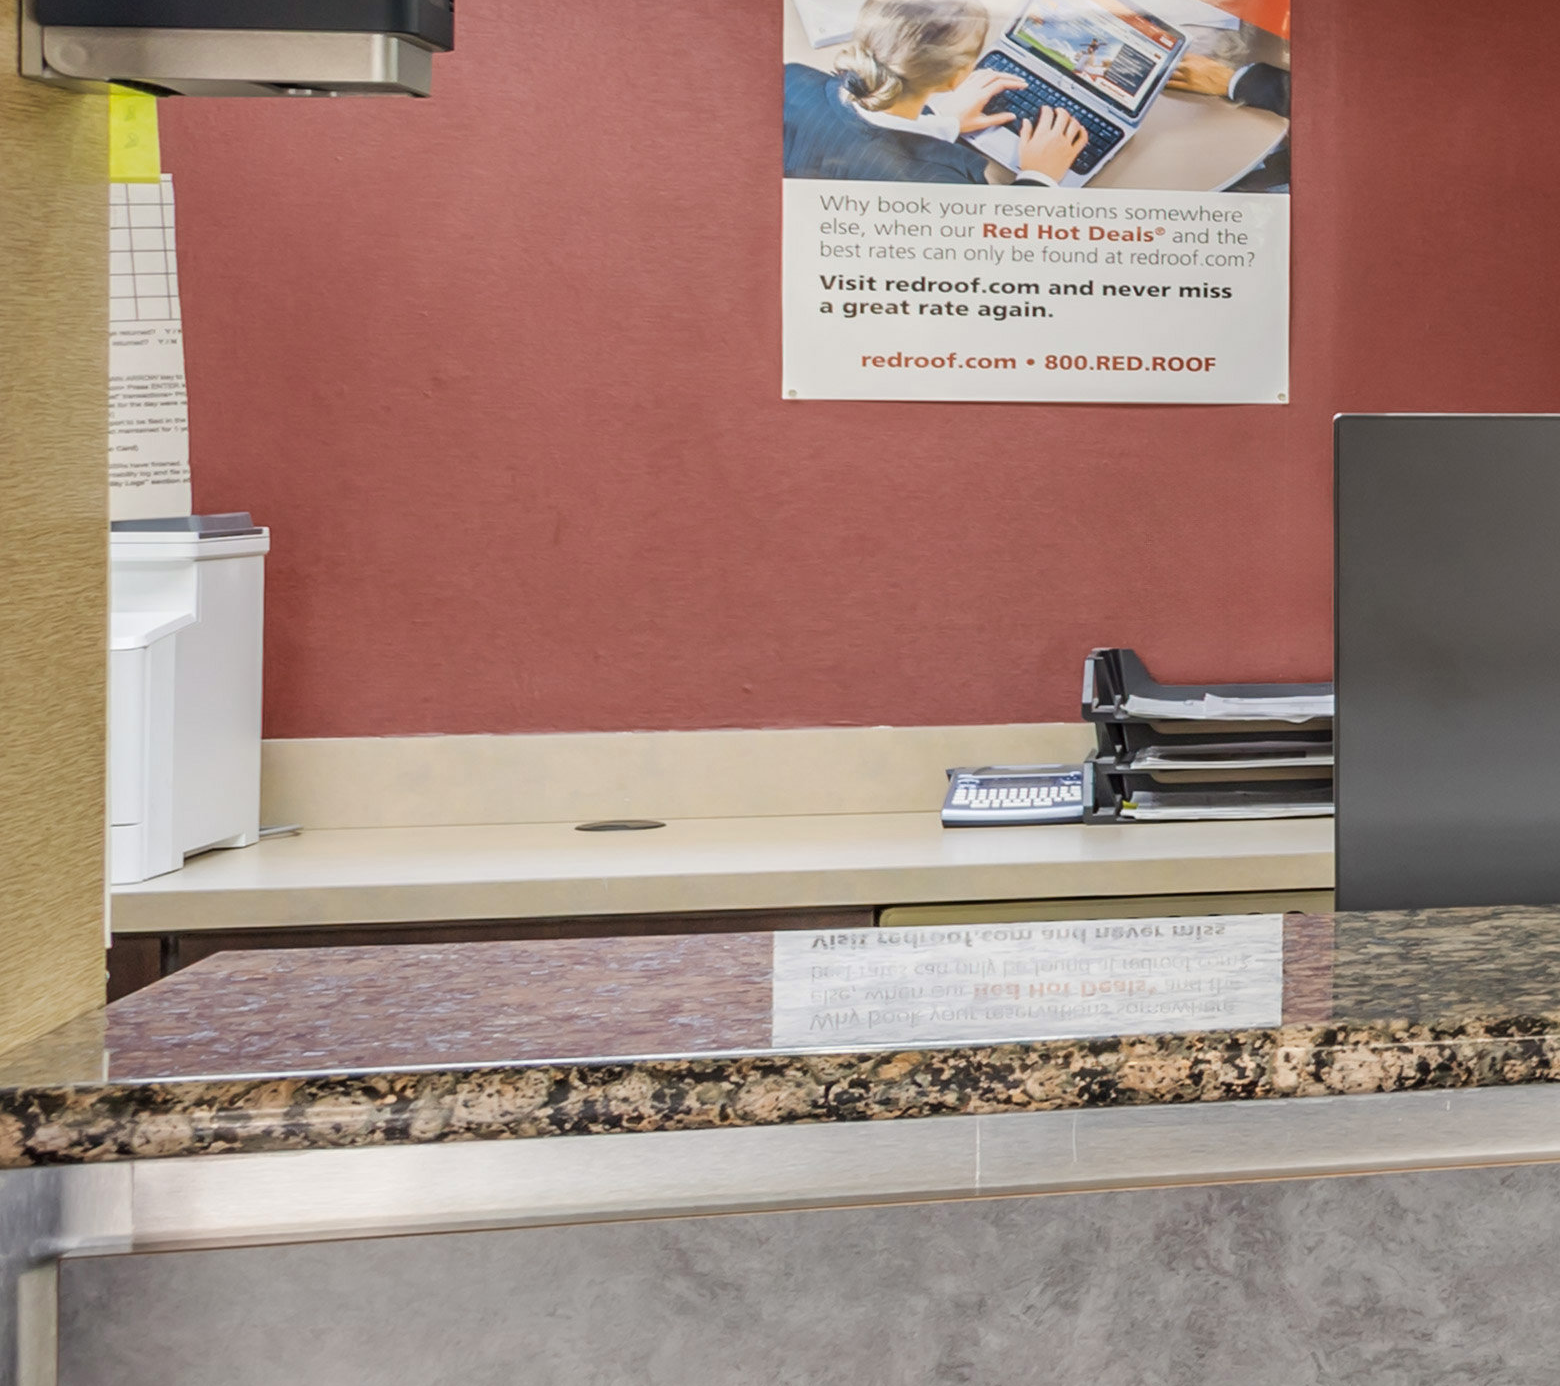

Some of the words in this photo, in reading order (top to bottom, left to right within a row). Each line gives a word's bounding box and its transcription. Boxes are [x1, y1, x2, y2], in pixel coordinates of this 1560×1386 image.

[820, 195, 870, 216] Why
[878, 196, 931, 213] book
[940, 203, 986, 218] your
[995, 202, 1117, 219] reservations
[1125, 206, 1242, 223] somewhere
[820, 218, 865, 237] else,
[874, 220, 932, 236] when
[940, 225, 975, 237] our
[983, 223, 1028, 239] Red
[1038, 225, 1080, 240] Hot
[1173, 228, 1209, 244] and
[1217, 229, 1248, 245] the
[821, 241, 860, 258] best
[869, 245, 916, 259] rates
[923, 248, 956, 260] can
[964, 245, 1004, 265] only
[1012, 246, 1034, 262] be
[1042, 246, 1098, 264] found
[1105, 251, 1123, 264] at
[1131, 249, 1255, 267] redroof.com?
[820, 275, 876, 291] Visit
[886, 277, 1039, 294] redroof.com
[1049, 280, 1093, 295] and
[1103, 285, 1171, 297] never
[1180, 283, 1232, 298] miss
[820, 302, 833, 313] a
[843, 301, 909, 318] great
[919, 301, 968, 316] rate
[978, 302, 1053, 321] again.
[862, 352, 1016, 369] redroof.com
[1045, 355, 1216, 372] 800.RED.ROOF
